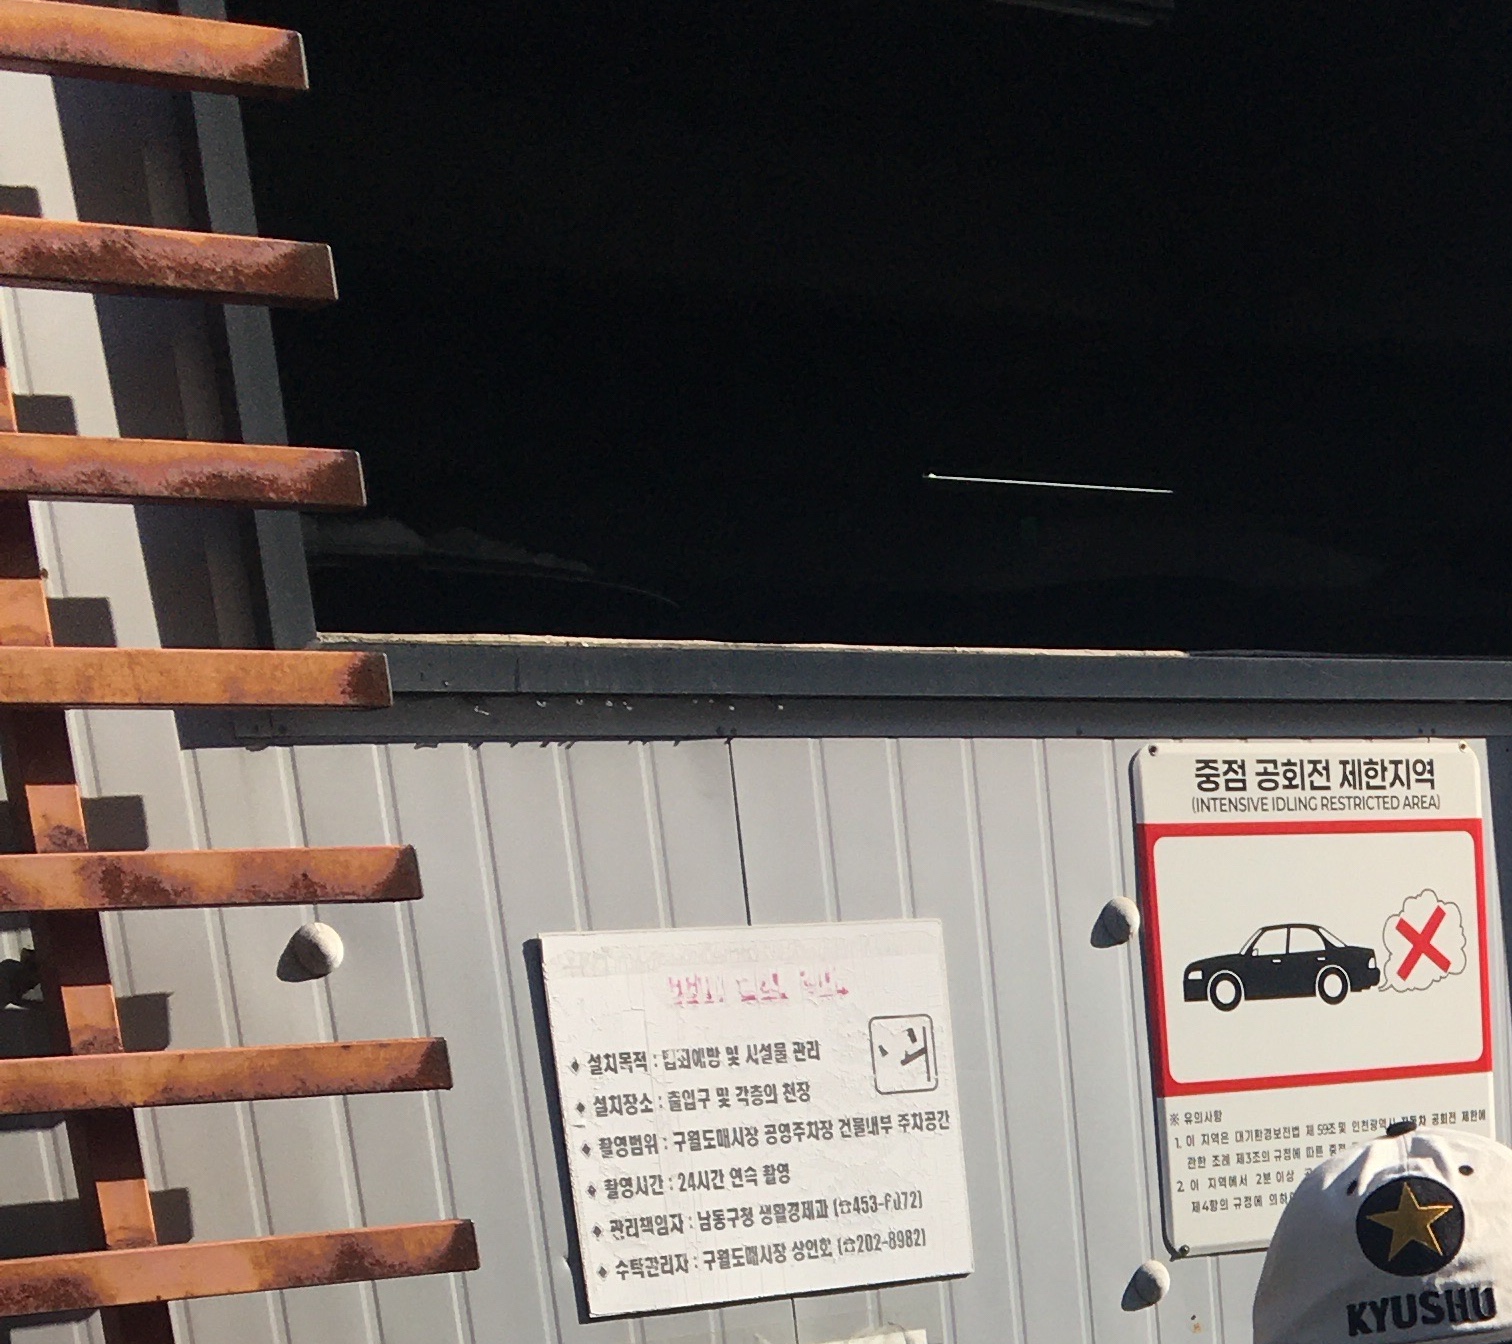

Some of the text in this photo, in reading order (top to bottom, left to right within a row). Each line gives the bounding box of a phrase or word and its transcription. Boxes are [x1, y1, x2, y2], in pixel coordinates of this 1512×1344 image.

[1195, 760, 1436, 792] 중점 공회전 제한지역
[1192, 795, 1441, 813] (INTENSIVE IDLING RESTRICTED AREA)
[588, 1051, 648, 1075] 설치목적
[726, 1045, 740, 1067] 및
[793, 1040, 820, 1061] 관리
[594, 1094, 654, 1117] 설치장소
[668, 1089, 710, 1112] 출입구
[716, 1087, 730, 1108] 및
[737, 1083, 779, 1107] 각층의
[783, 1083, 810, 1102] 천장
[599, 1134, 659, 1158] 촬영범위
[673, 1125, 759, 1153] 구월도매시장
[764, 1120, 833, 1145] 공영주차장
[839, 1115, 892, 1138] 건물내부
[898, 1111, 950, 1133] 주차공간
[1184, 1110, 1222, 1125] 유의사항
[1187, 1135, 1194, 1146] 이
[1201, 1131, 1229, 1145] 지역은
[1235, 1126, 1299, 1142] 대기환경보전법
[1432, 1112, 1456, 1125] 공회전
[1462, 1109, 1486, 1121] 제한에
[1188, 1156, 1206, 1170] 관한
[1212, 1154, 1230, 1167] 조례
[1237, 1151, 1270, 1164] 제3조의
[1274, 1147, 1300, 1161] 규정에
[1306, 1145, 1323, 1158] 따른
[604, 1174, 664, 1199] 촬영시간
[678, 1170, 724, 1192] 24시간
[730, 1166, 757, 1190] 연속
[763, 1164, 790, 1185] 촬영
[1191, 1179, 1198, 1191] 이
[1208, 1175, 1247, 1188] 지역에서
[1257, 1173, 1271, 1185] 2분
[1276, 1170, 1294, 1183] 이상
[610, 1214, 684, 1240] 관리책임자
[699, 1204, 755, 1234] 남동구청
[759, 1199, 828, 1225] 생활경제과
[1192, 1199, 1228, 1213] 제4항의
[1234, 1196, 1262, 1209] 규정에
[616, 1254, 690, 1280] 수탁관리자
[703, 1242, 787, 1271] 구월도매시장
[1346, 1286, 1496, 1337] KYUSHU
